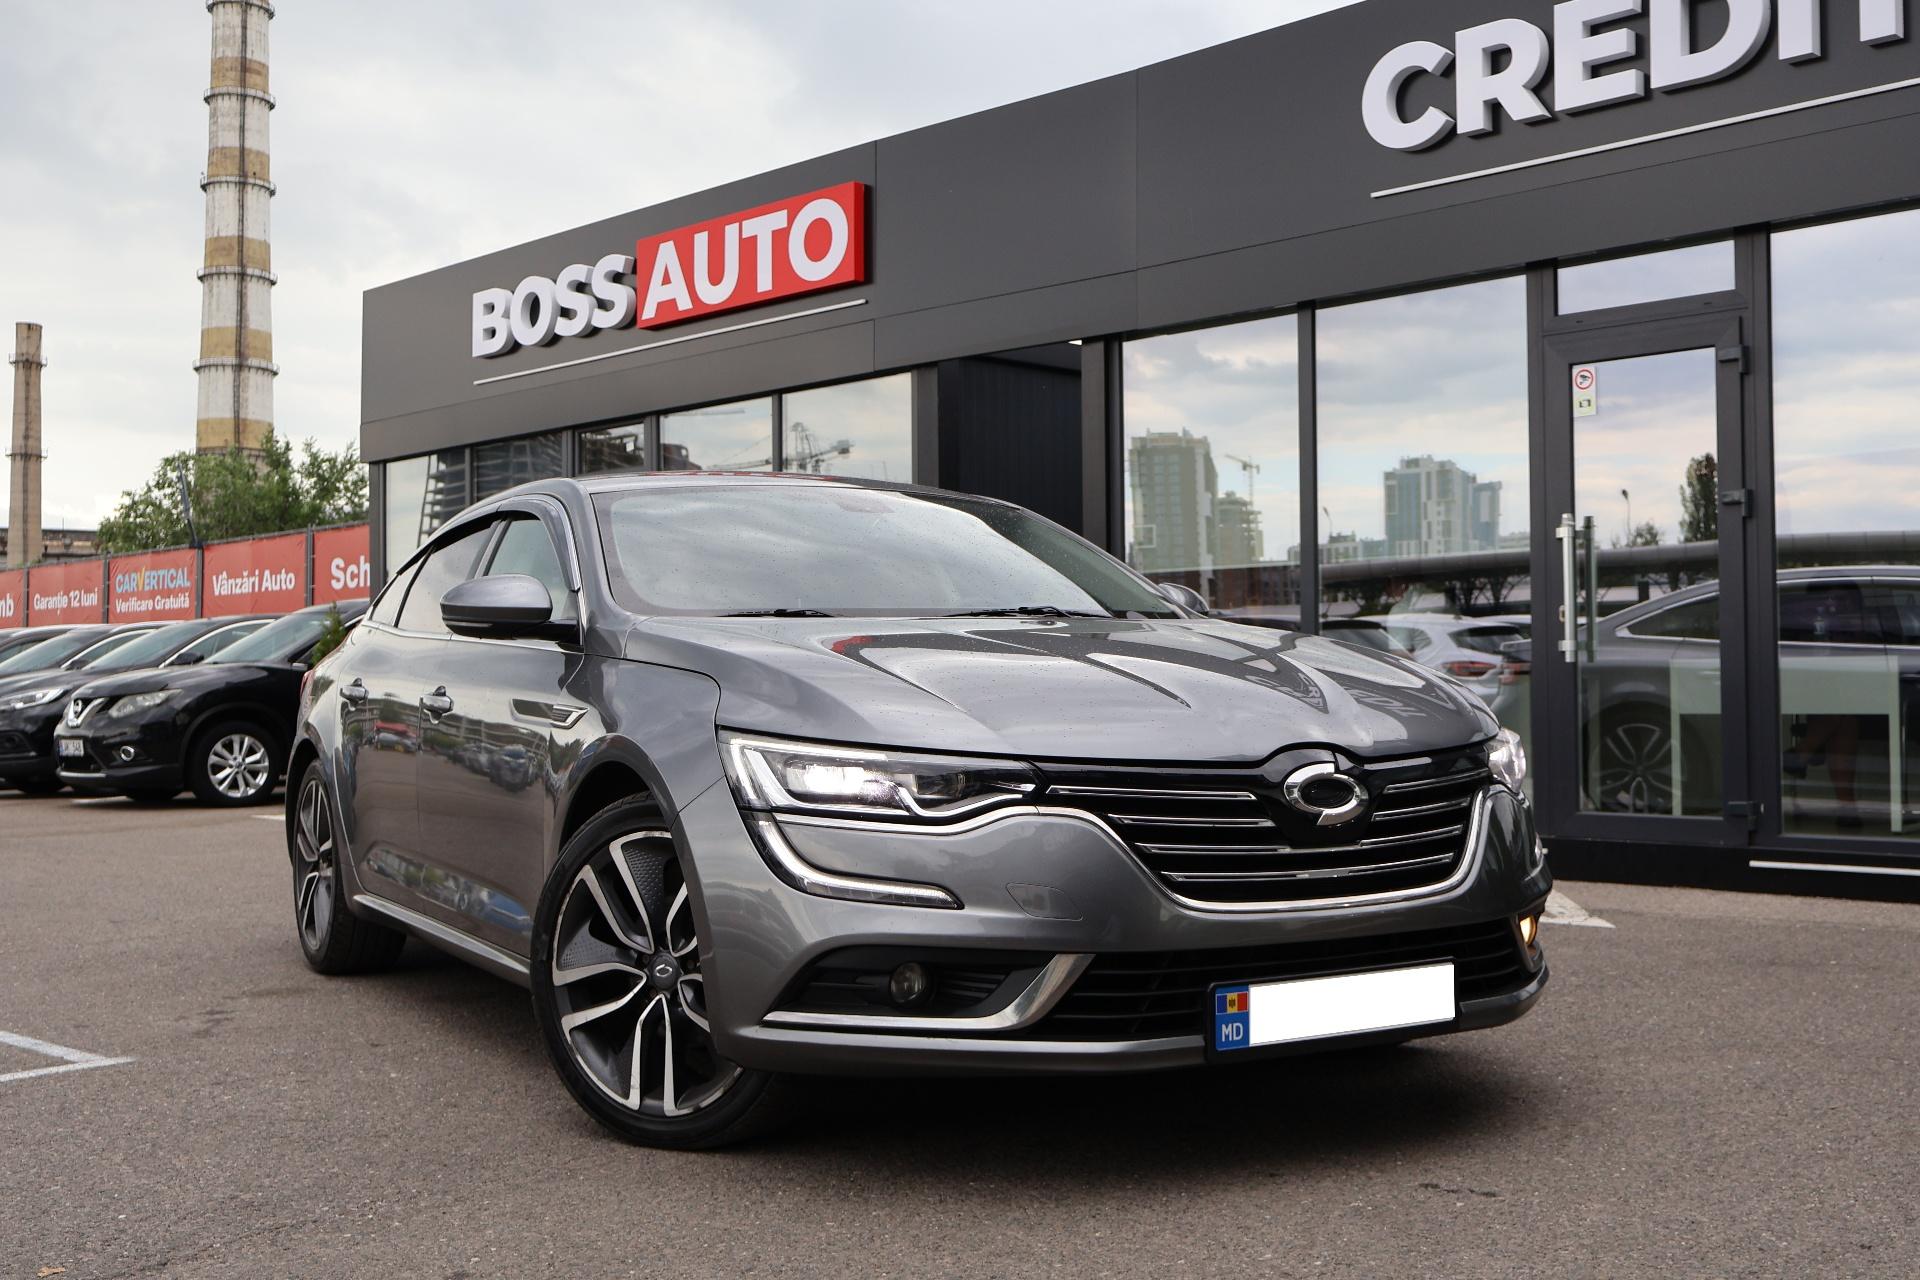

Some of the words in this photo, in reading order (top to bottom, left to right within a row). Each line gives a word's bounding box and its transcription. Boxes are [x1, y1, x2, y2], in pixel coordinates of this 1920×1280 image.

[472, 253, 637, 358] BOSS
[641, 198, 849, 320] AUTO
[212, 569, 259, 596] Vânzări
[261, 568, 296, 592] Auto
[69, 589, 80, 608] 12
[81, 587, 98, 606] luni
[1221, 1022, 1243, 1042] MD
